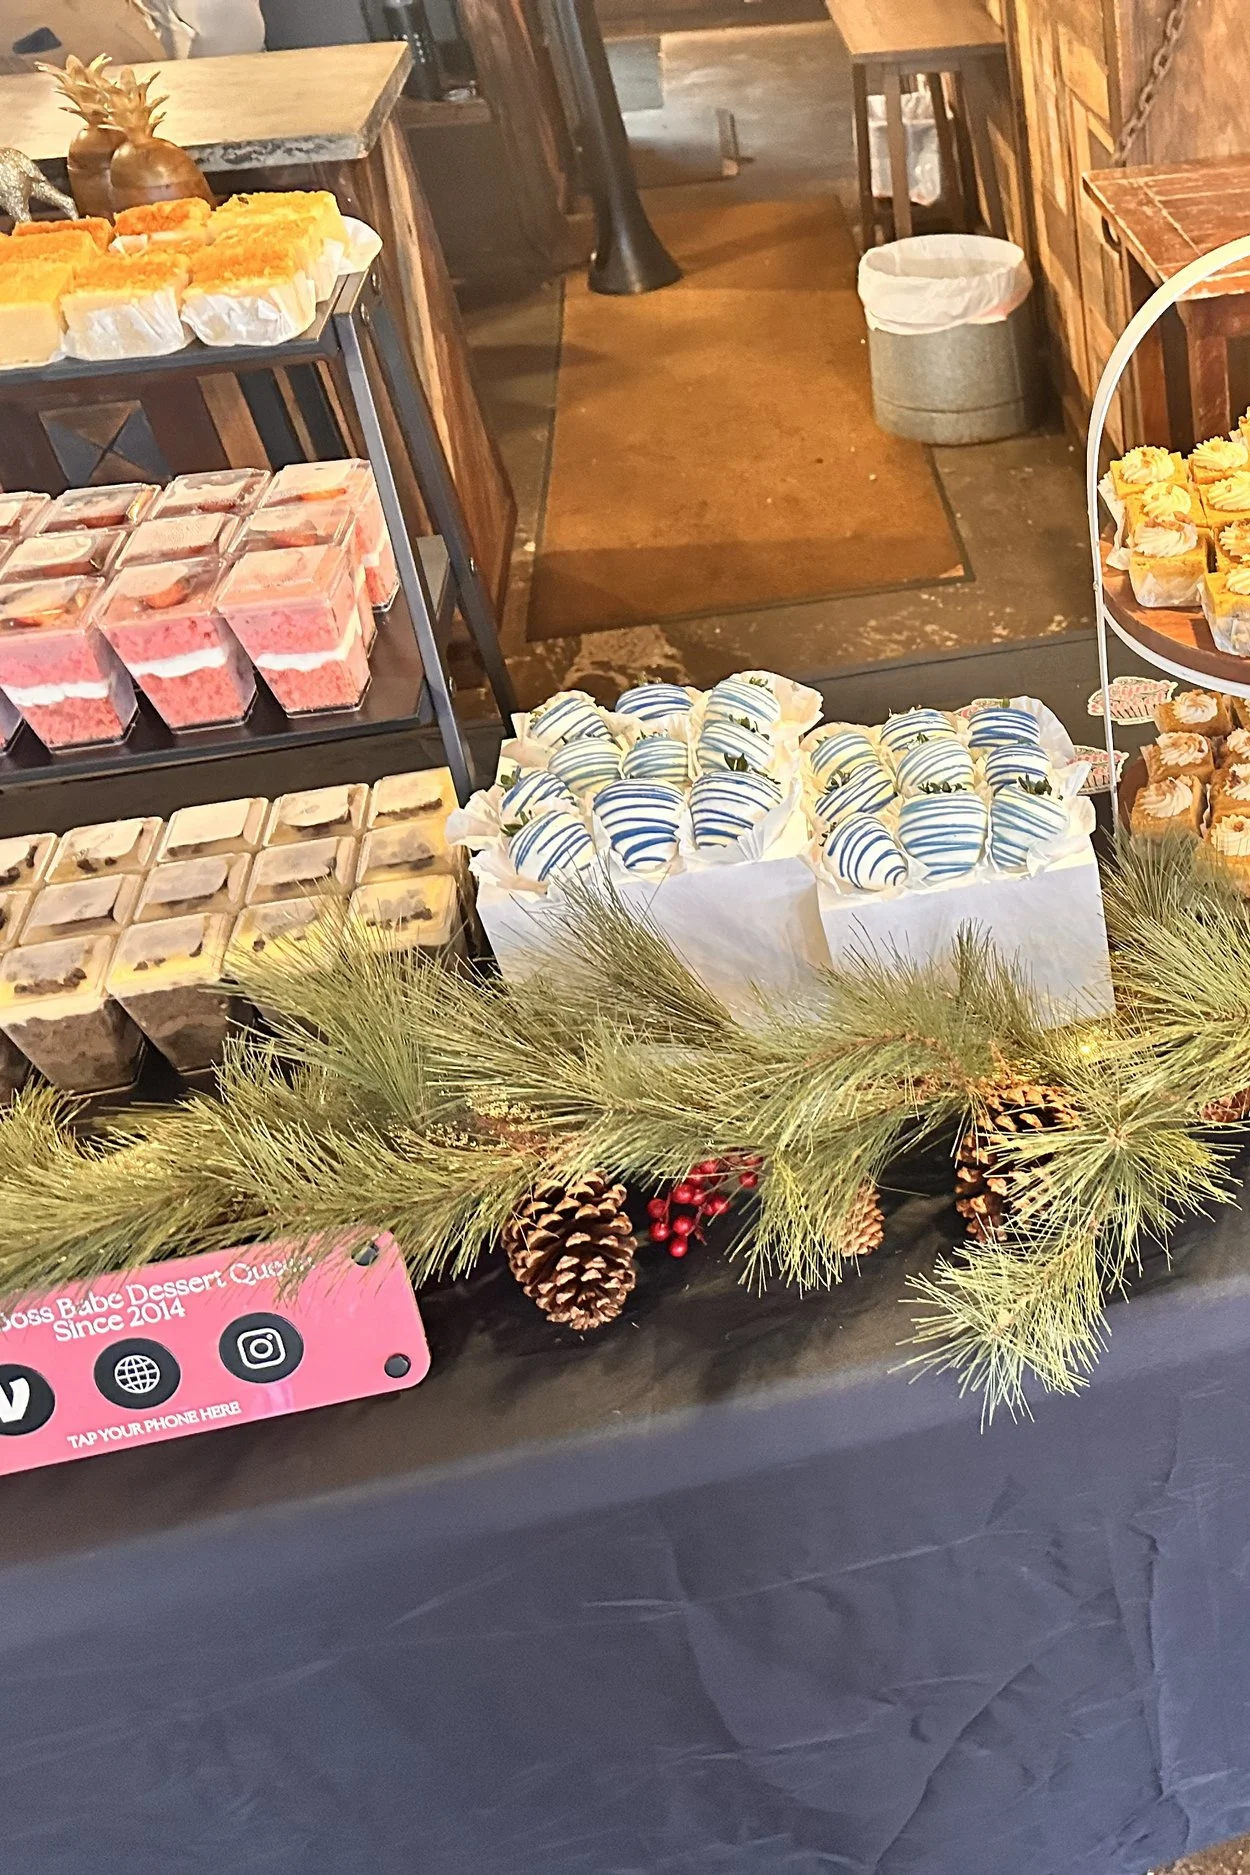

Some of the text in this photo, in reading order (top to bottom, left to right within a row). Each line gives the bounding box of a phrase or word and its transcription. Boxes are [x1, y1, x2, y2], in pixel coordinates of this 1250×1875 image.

[56, 1290, 125, 1319] Babe
[126, 1269, 227, 1306] Dessert
[229, 1256, 316, 1286] Que
[53, 1298, 186, 1342] Since 2014
[66, 1401, 242, 1449] TAP YOUR PHONE HERE
